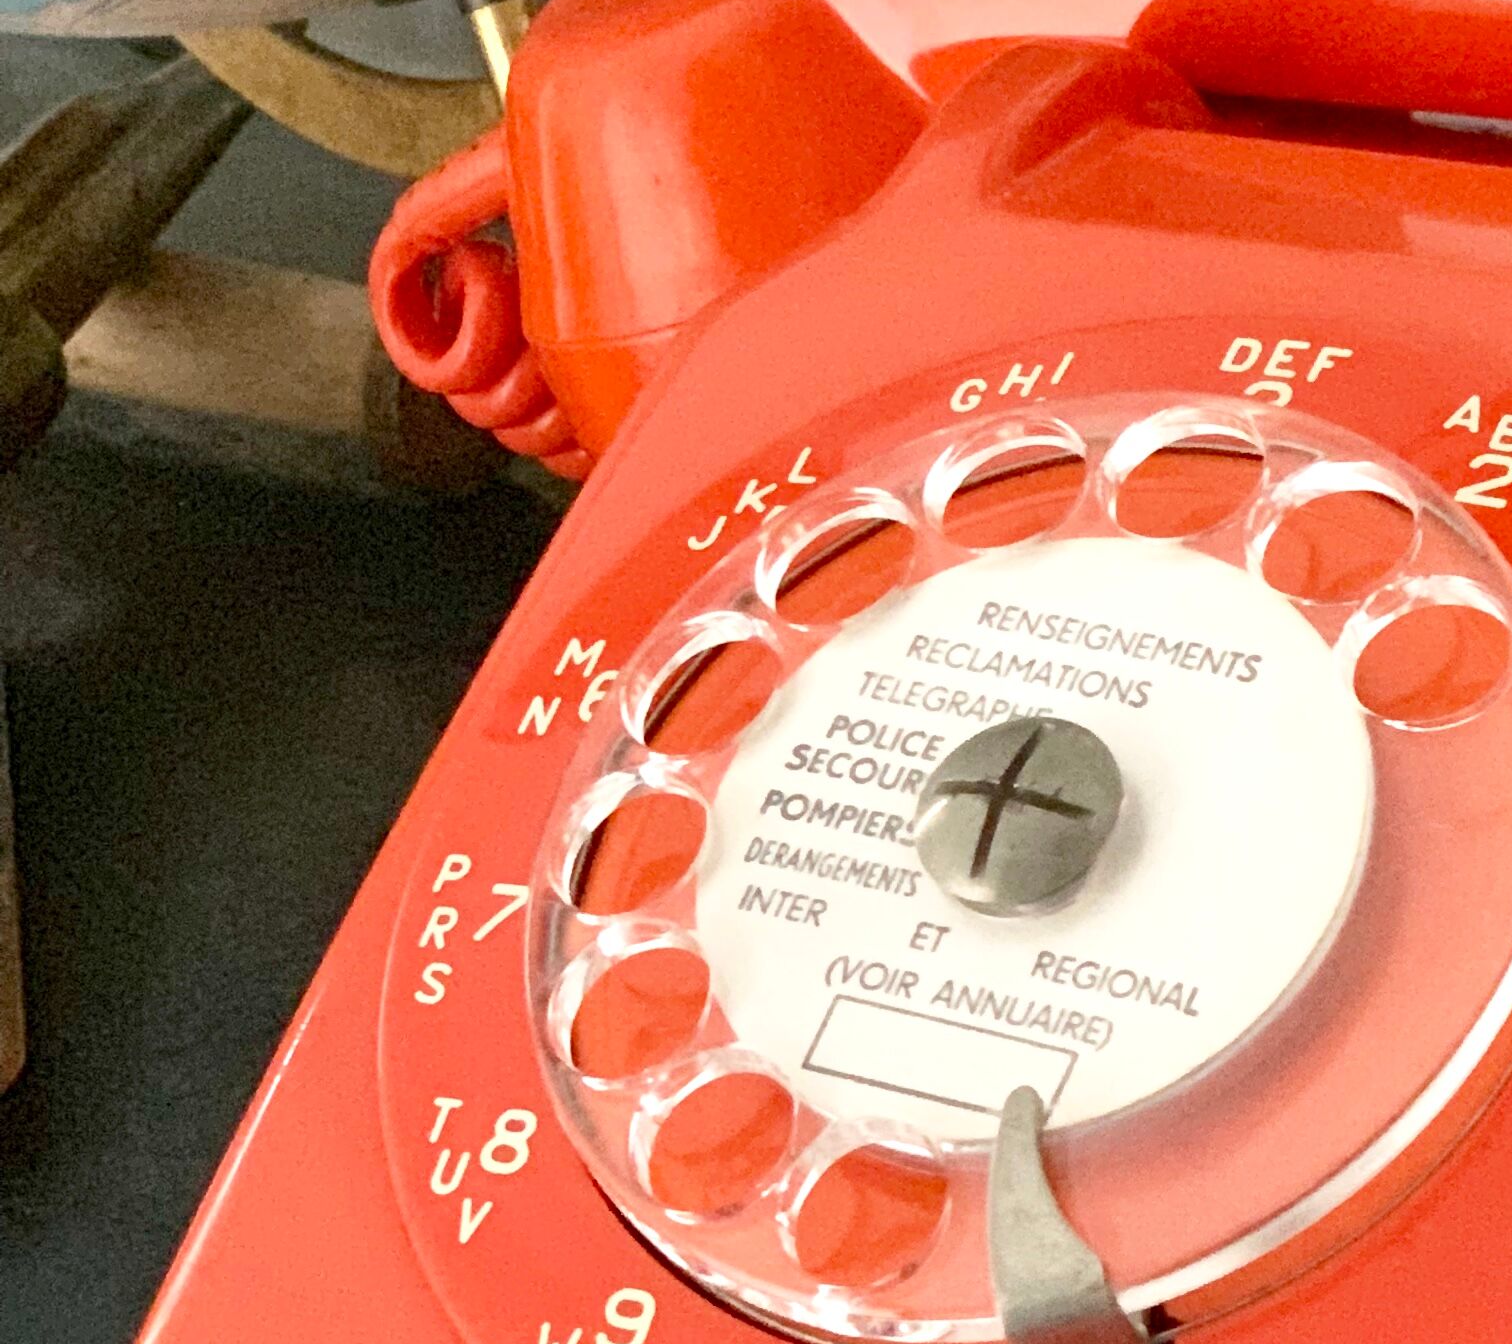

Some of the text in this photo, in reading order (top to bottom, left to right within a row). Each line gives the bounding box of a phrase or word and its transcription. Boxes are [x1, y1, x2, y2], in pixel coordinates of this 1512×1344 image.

[950, 351, 1076, 413] GHI
[1219, 337, 1354, 383] DEF
[687, 446, 817, 552] JKL
[905, 633, 1152, 709] RECLAMATIONS
[976, 600, 1263, 685] RENSEIGNEMENTS
[825, 713, 946, 763] POLICE
[742, 835, 923, 899] DERANGEMENTS
[471, 882, 531, 943] 7
[737, 884, 1200, 1018] INTER ET REGIONAL
[823, 955, 1114, 1053] (VOIR ANNUAIRE)
[478, 1108, 538, 1175] 8
